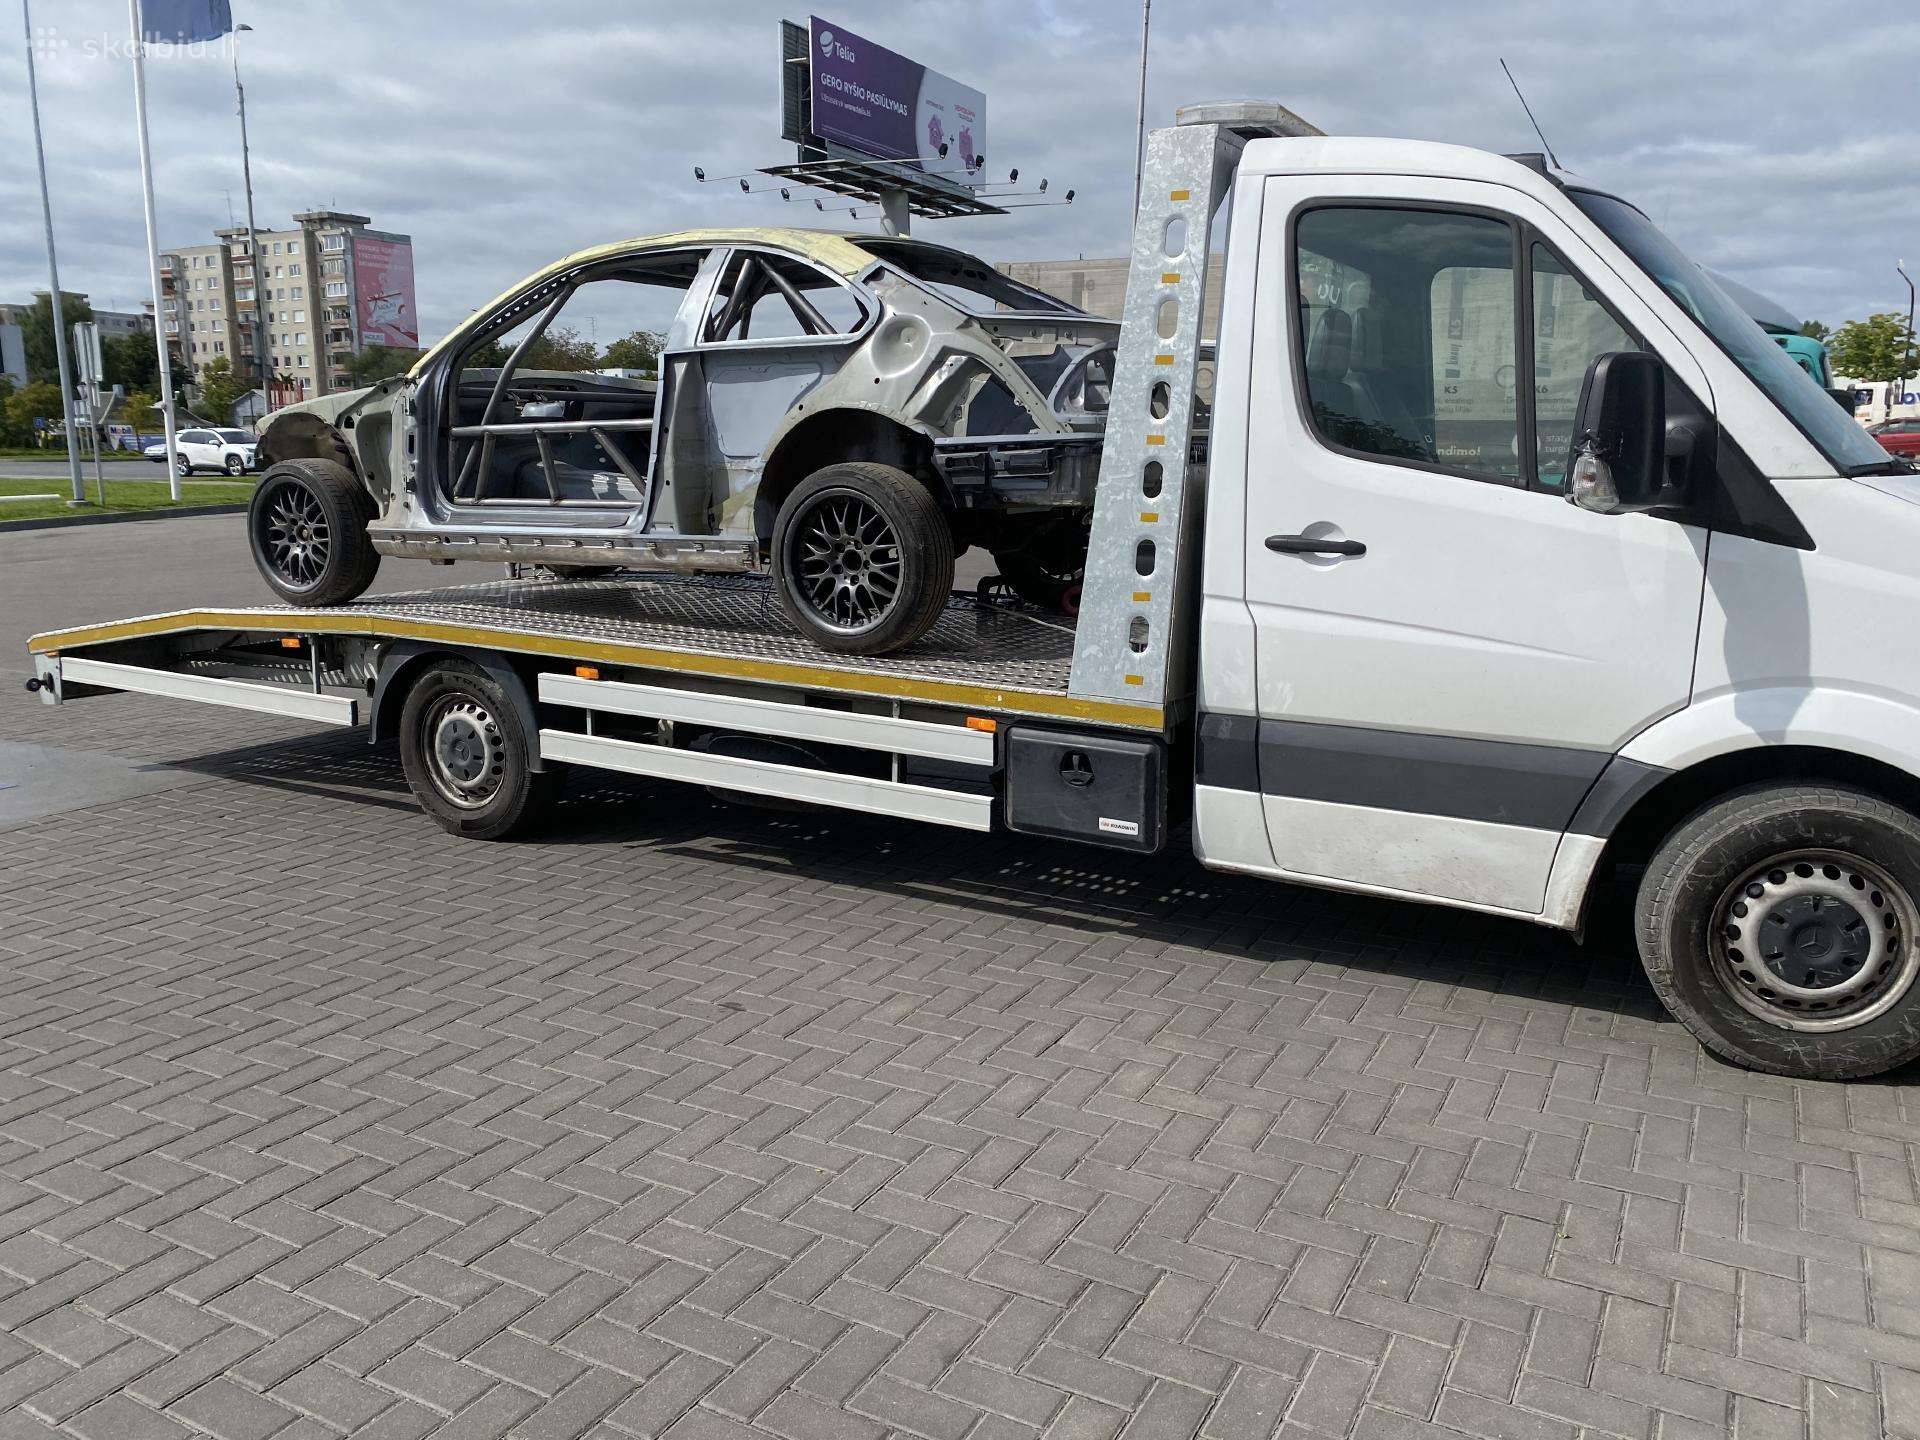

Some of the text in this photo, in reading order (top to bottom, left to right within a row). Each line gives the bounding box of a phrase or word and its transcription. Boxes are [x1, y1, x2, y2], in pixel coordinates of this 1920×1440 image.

[834, 41, 855, 63] Telia
[820, 72, 843, 91] GERO
[843, 81, 866, 100] RYŠIO
[866, 90, 908, 116] PASIŪLYMAS
